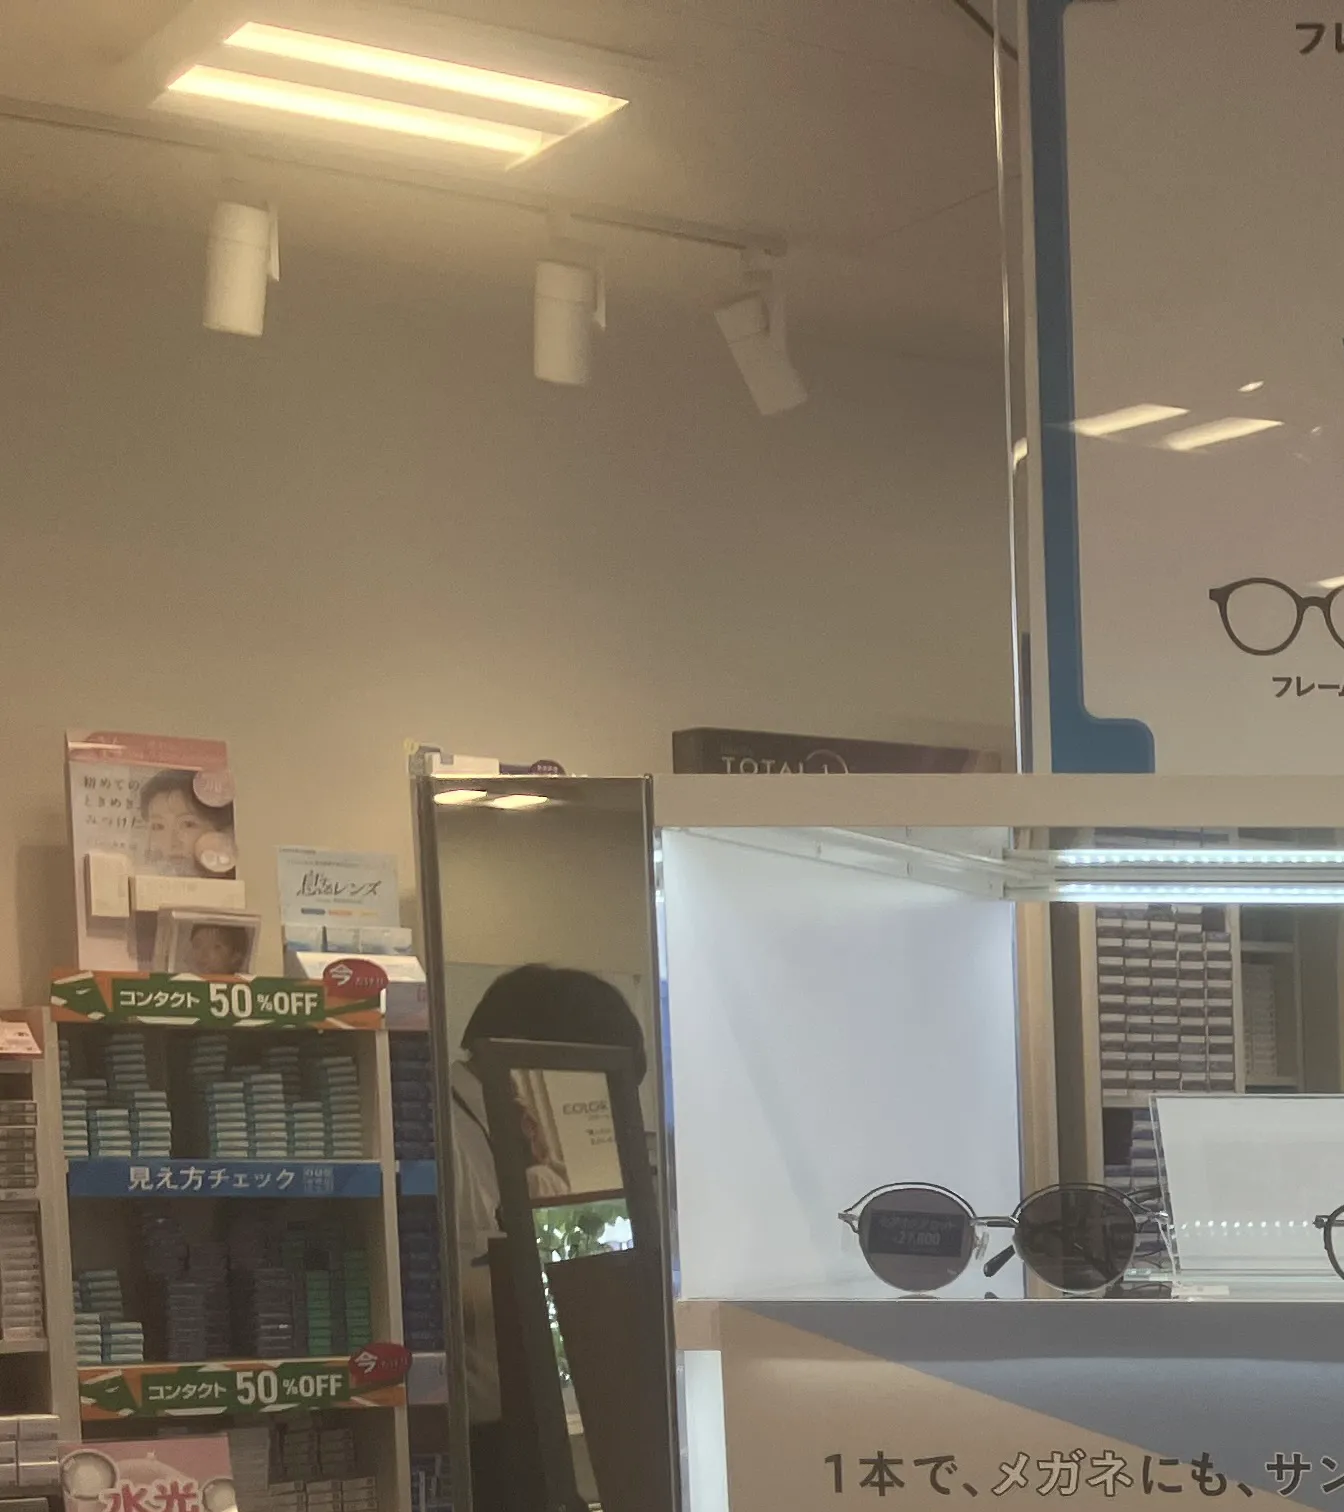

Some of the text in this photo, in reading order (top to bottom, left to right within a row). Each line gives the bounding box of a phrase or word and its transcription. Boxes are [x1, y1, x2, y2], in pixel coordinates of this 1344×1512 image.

[119, 989, 201, 1010] コンタクト
[128, 1166, 296, 1193] 見え方チェック
[147, 1382, 227, 1400] コンタクト
